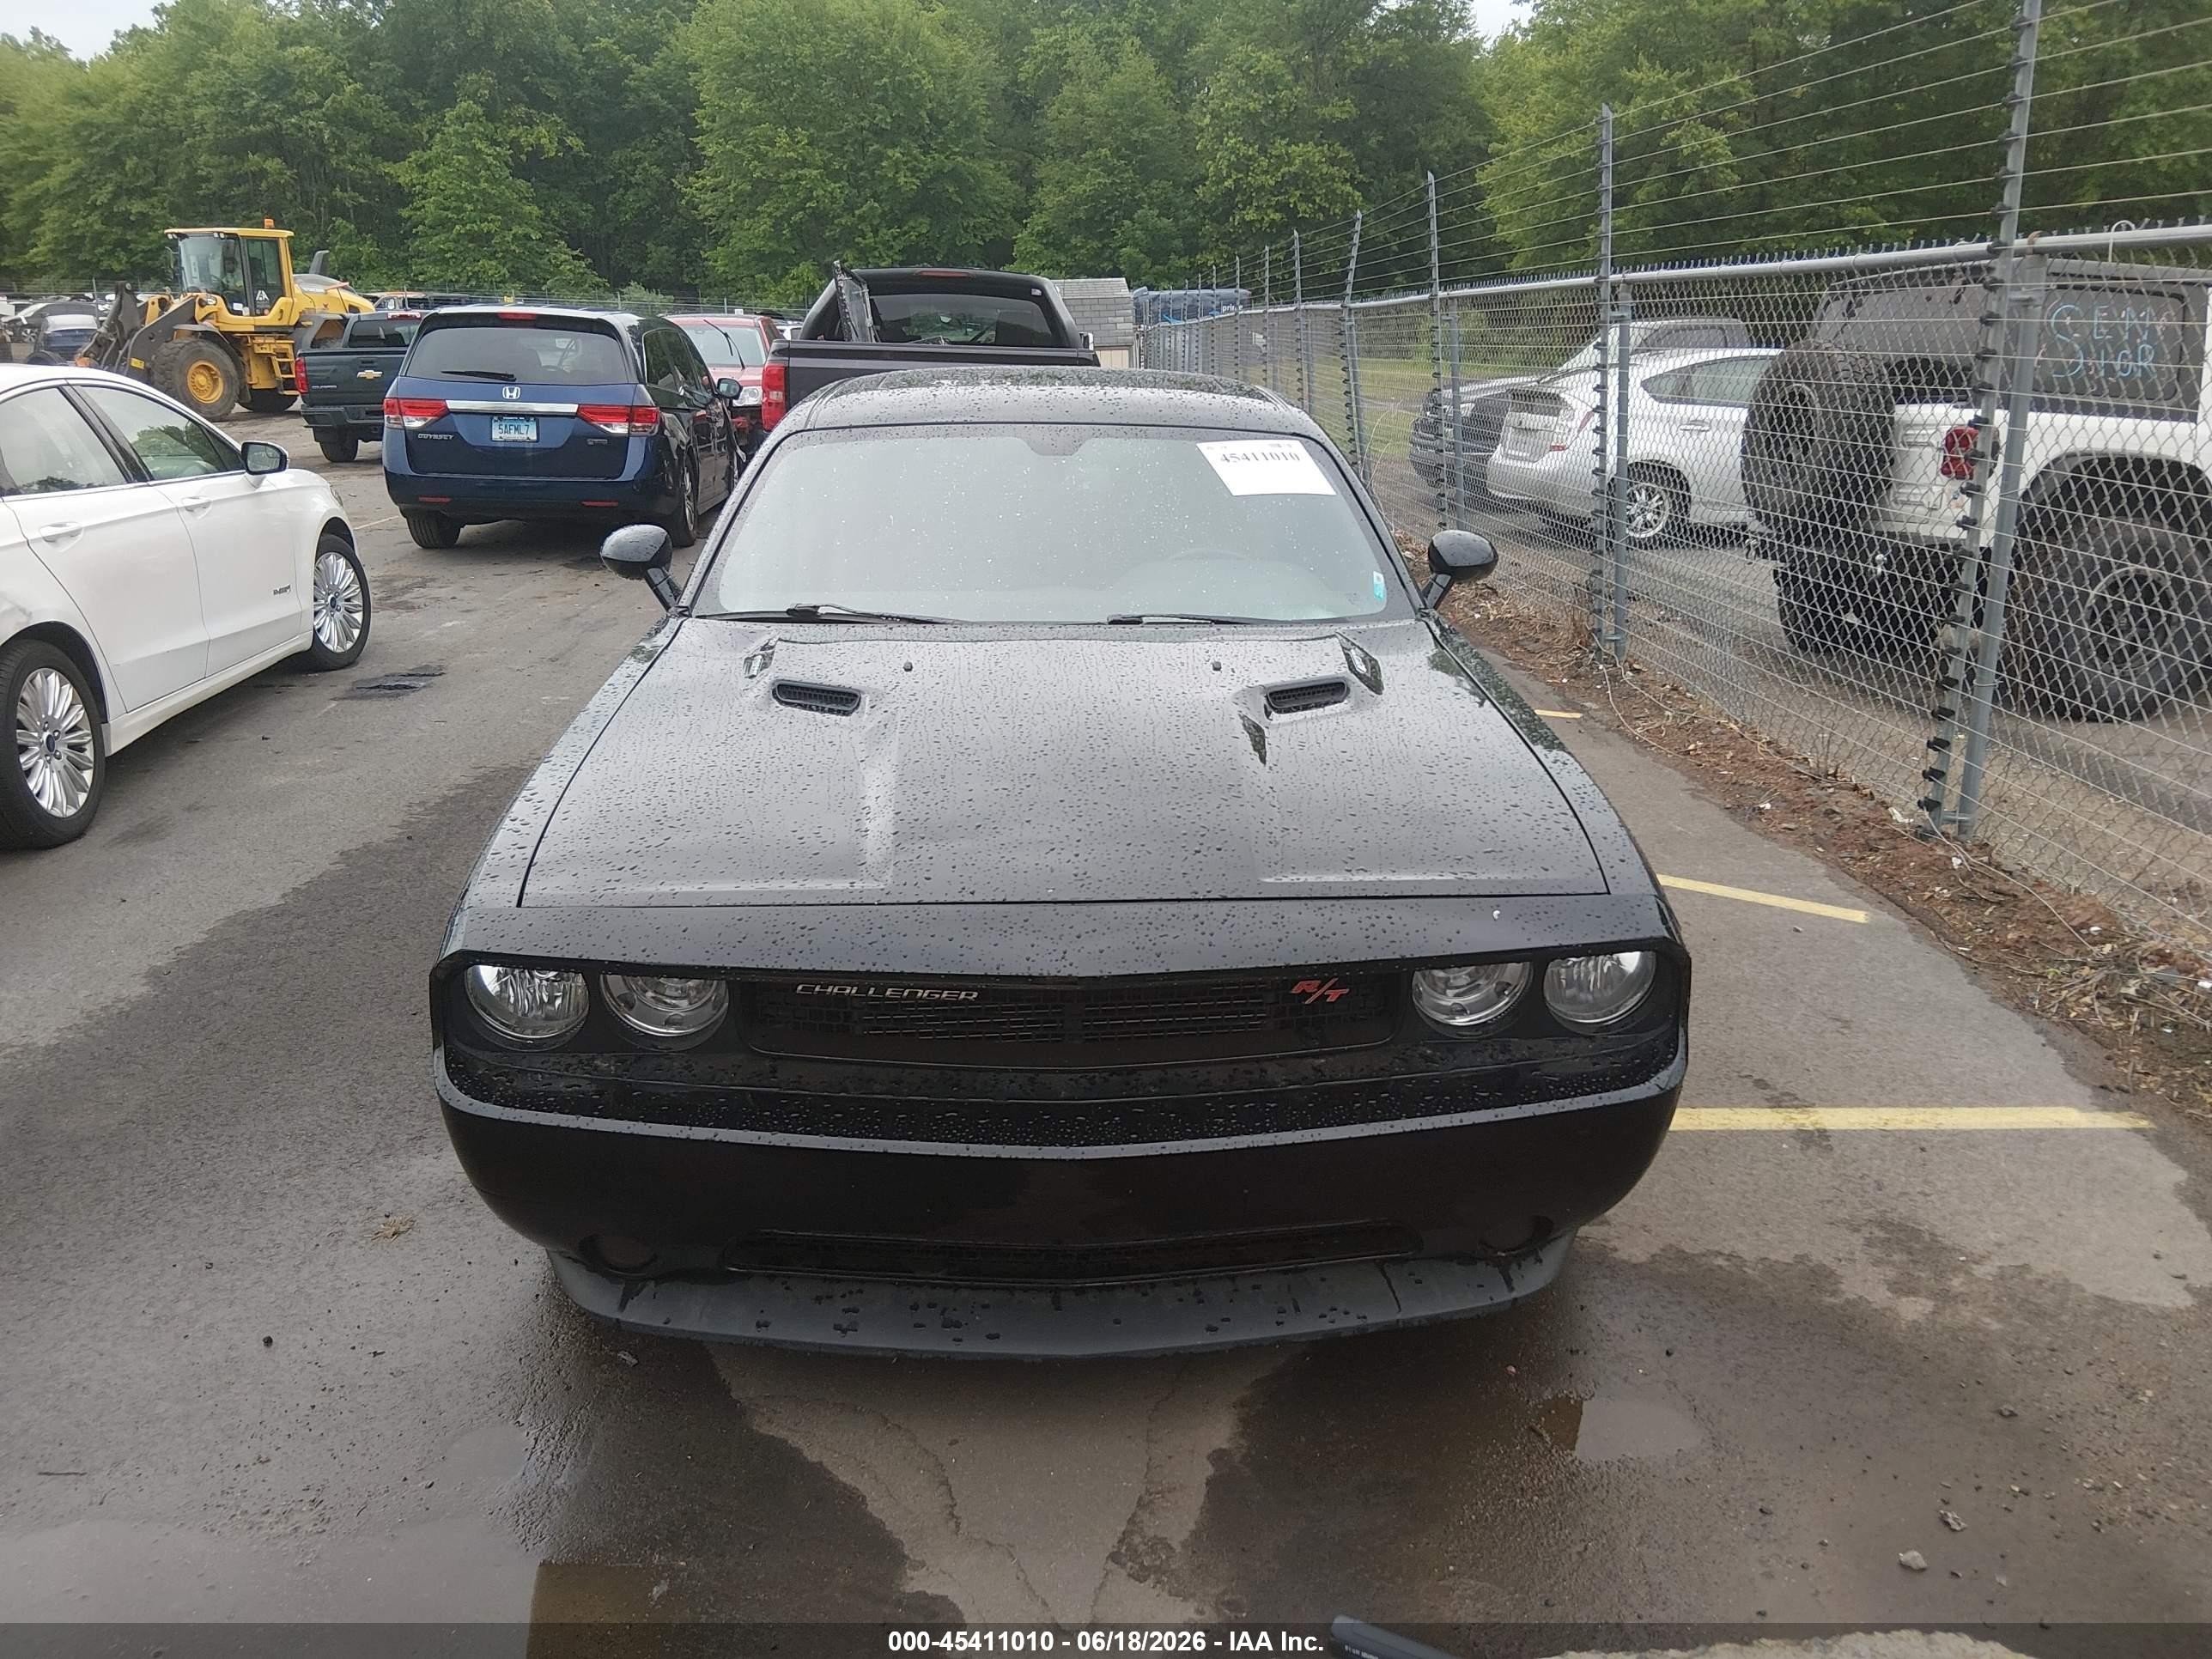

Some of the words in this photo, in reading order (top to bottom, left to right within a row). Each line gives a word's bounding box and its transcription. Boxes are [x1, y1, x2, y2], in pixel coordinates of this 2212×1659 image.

[498, 423, 530, 434] 5AFML7
[1220, 452, 1301, 463] 45411010
[796, 984, 979, 1001] CHALLENGER
[1290, 977, 1350, 1004] R/T
